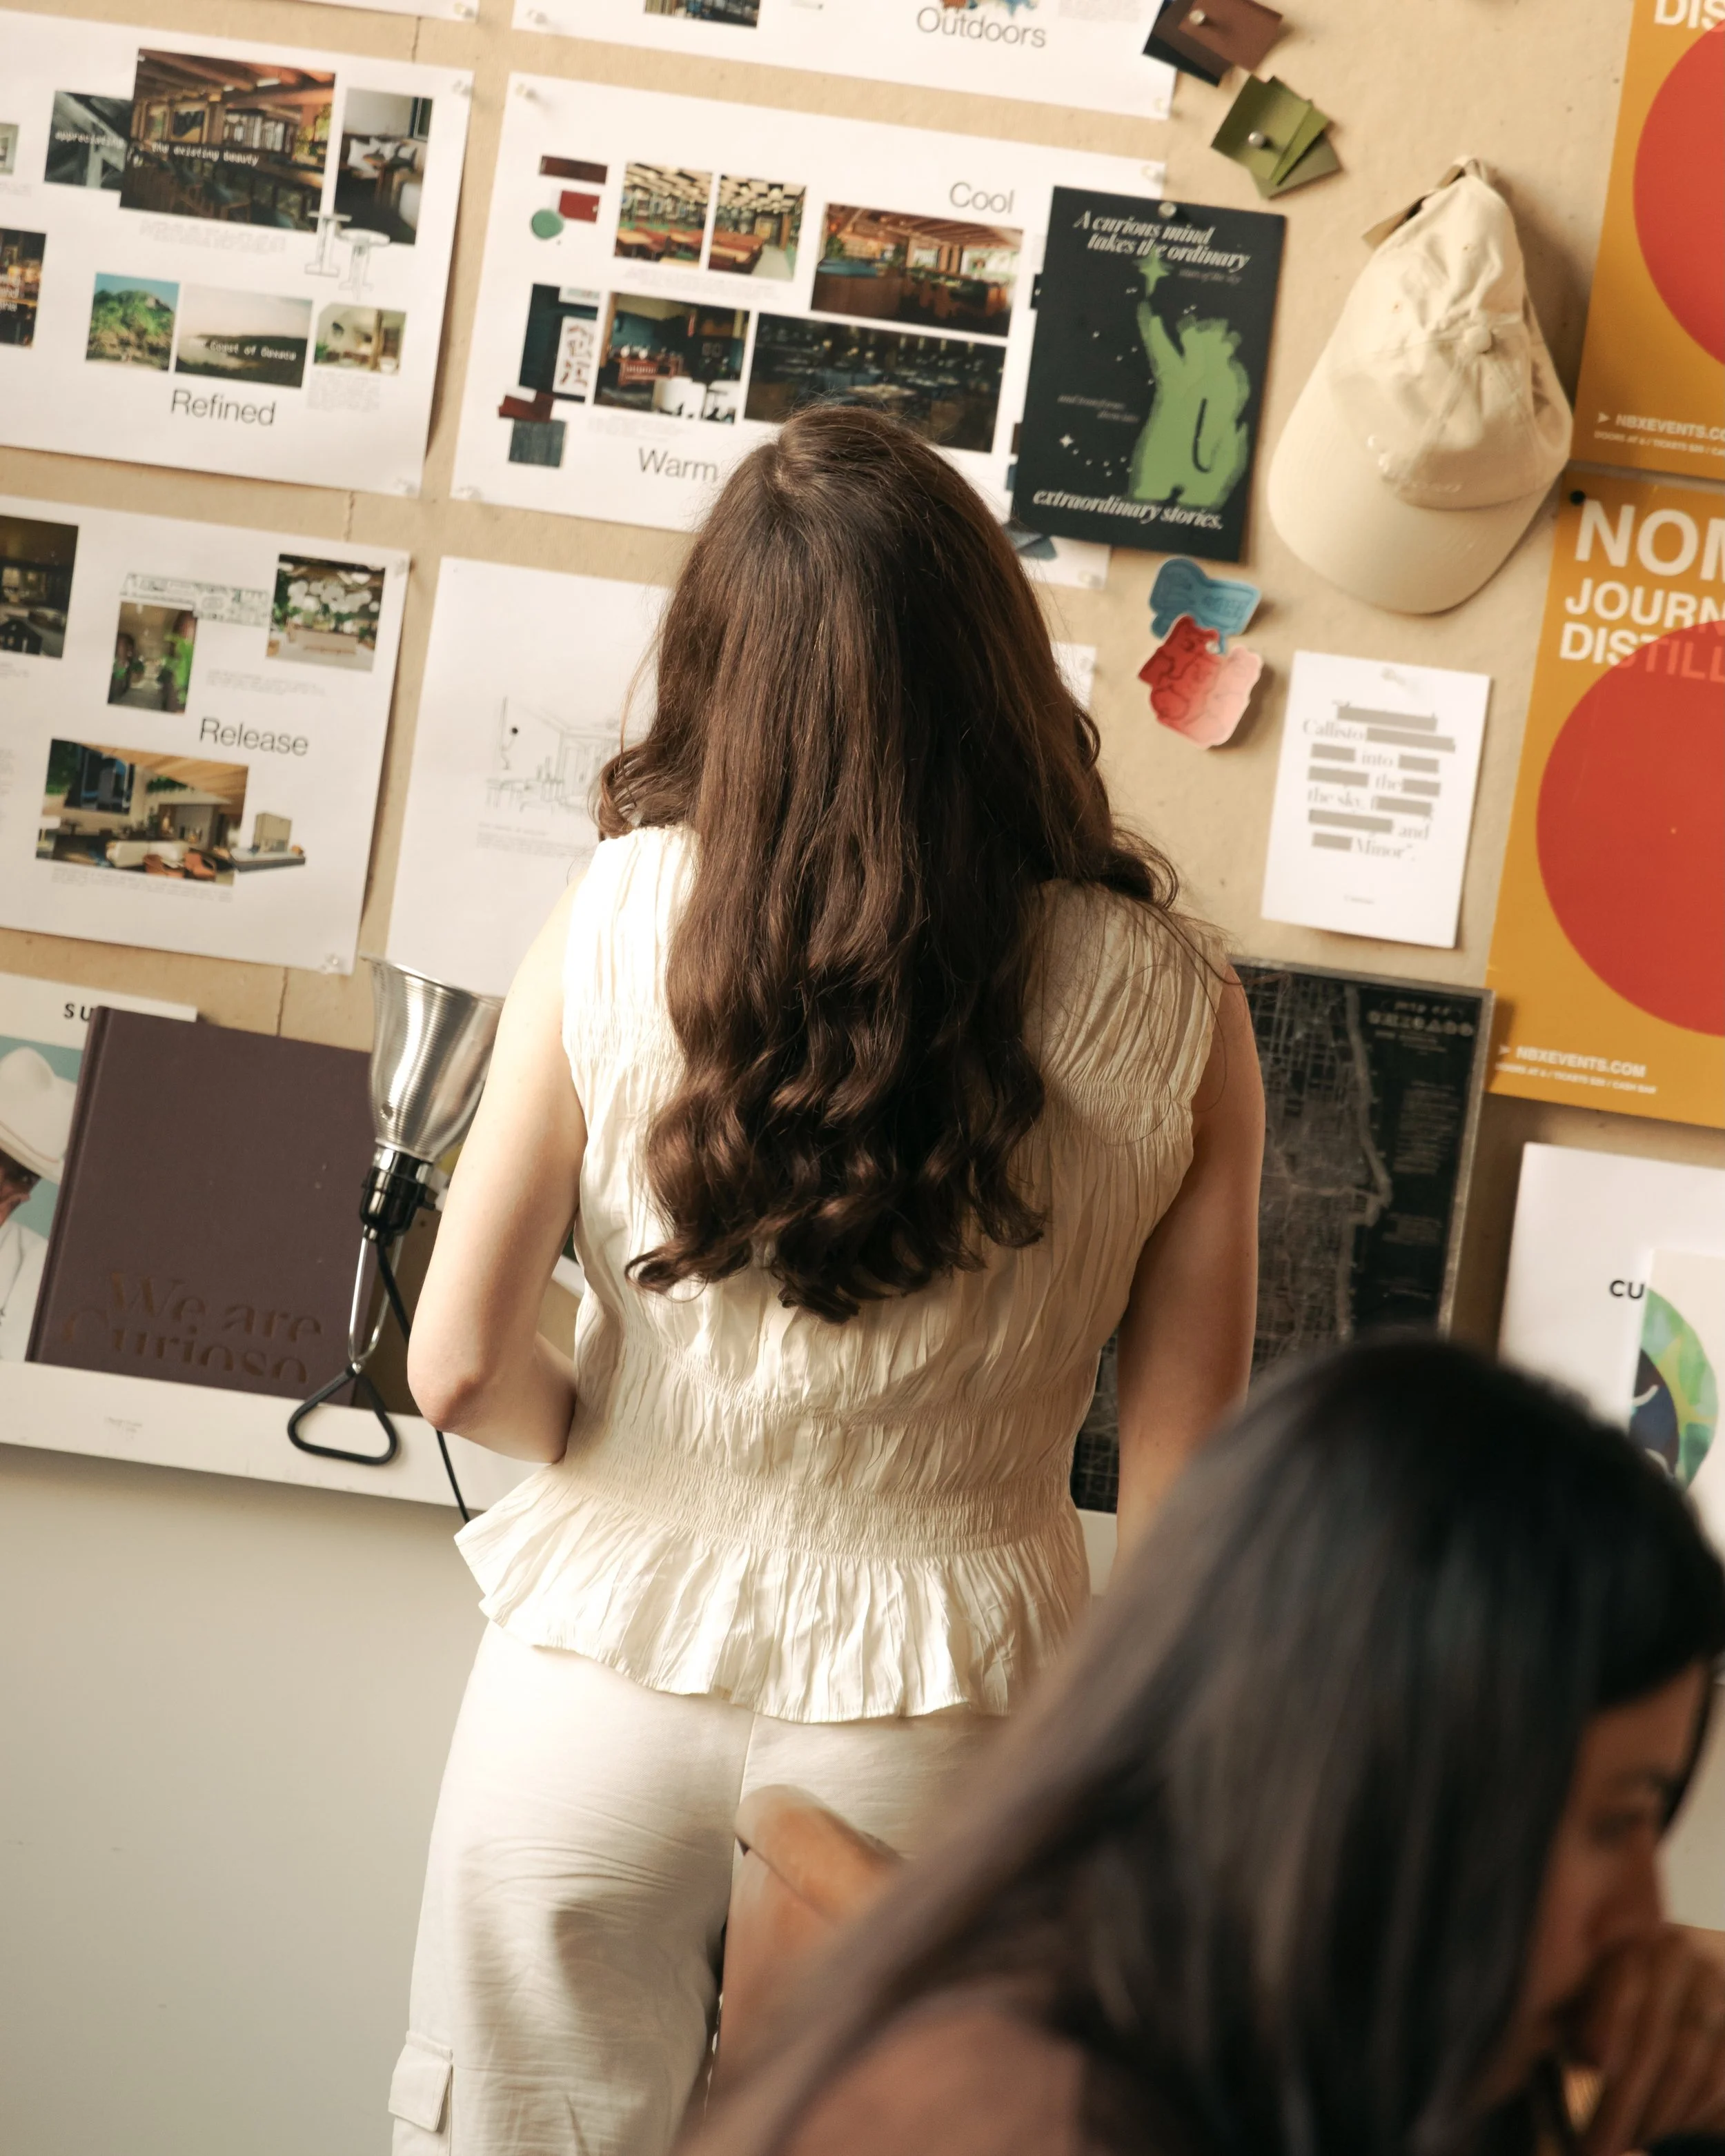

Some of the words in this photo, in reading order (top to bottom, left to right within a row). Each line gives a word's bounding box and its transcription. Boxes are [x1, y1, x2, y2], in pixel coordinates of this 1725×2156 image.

[916, 6, 1047, 48] Outdoors
[151, 141, 170, 154] the
[173, 146, 220, 163] existing
[223, 148, 260, 168] beauty
[949, 181, 1015, 215] Cool
[1073, 210, 1092, 230] A
[1092, 215, 1162, 238] curious
[1161, 224, 1216, 245] mind
[1087, 233, 1137, 255] takes
[1136, 239, 1168, 259] the
[1167, 245, 1252, 274] ordinary
[210, 340, 239, 355] Coast
[244, 345, 257, 357] of
[171, 388, 276, 426] Refined
[639, 446, 718, 484] Warm
[1033, 489, 1160, 524] extraordinary
[1161, 506, 1223, 531] stories.
[1565, 577, 1725, 637] JOURN
[1559, 621, 1725, 684] DISTILL
[199, 716, 308, 756] Release
[1361, 751, 1393, 767] into
[1308, 787, 1334, 804] the
[1398, 822, 1430, 841] and
[1515, 1045, 1647, 1078] NBXEVENTS.COM
[109, 1272, 207, 1325] We
[224, 1303, 323, 1344] are
[1609, 1280, 1645, 1300] CU
